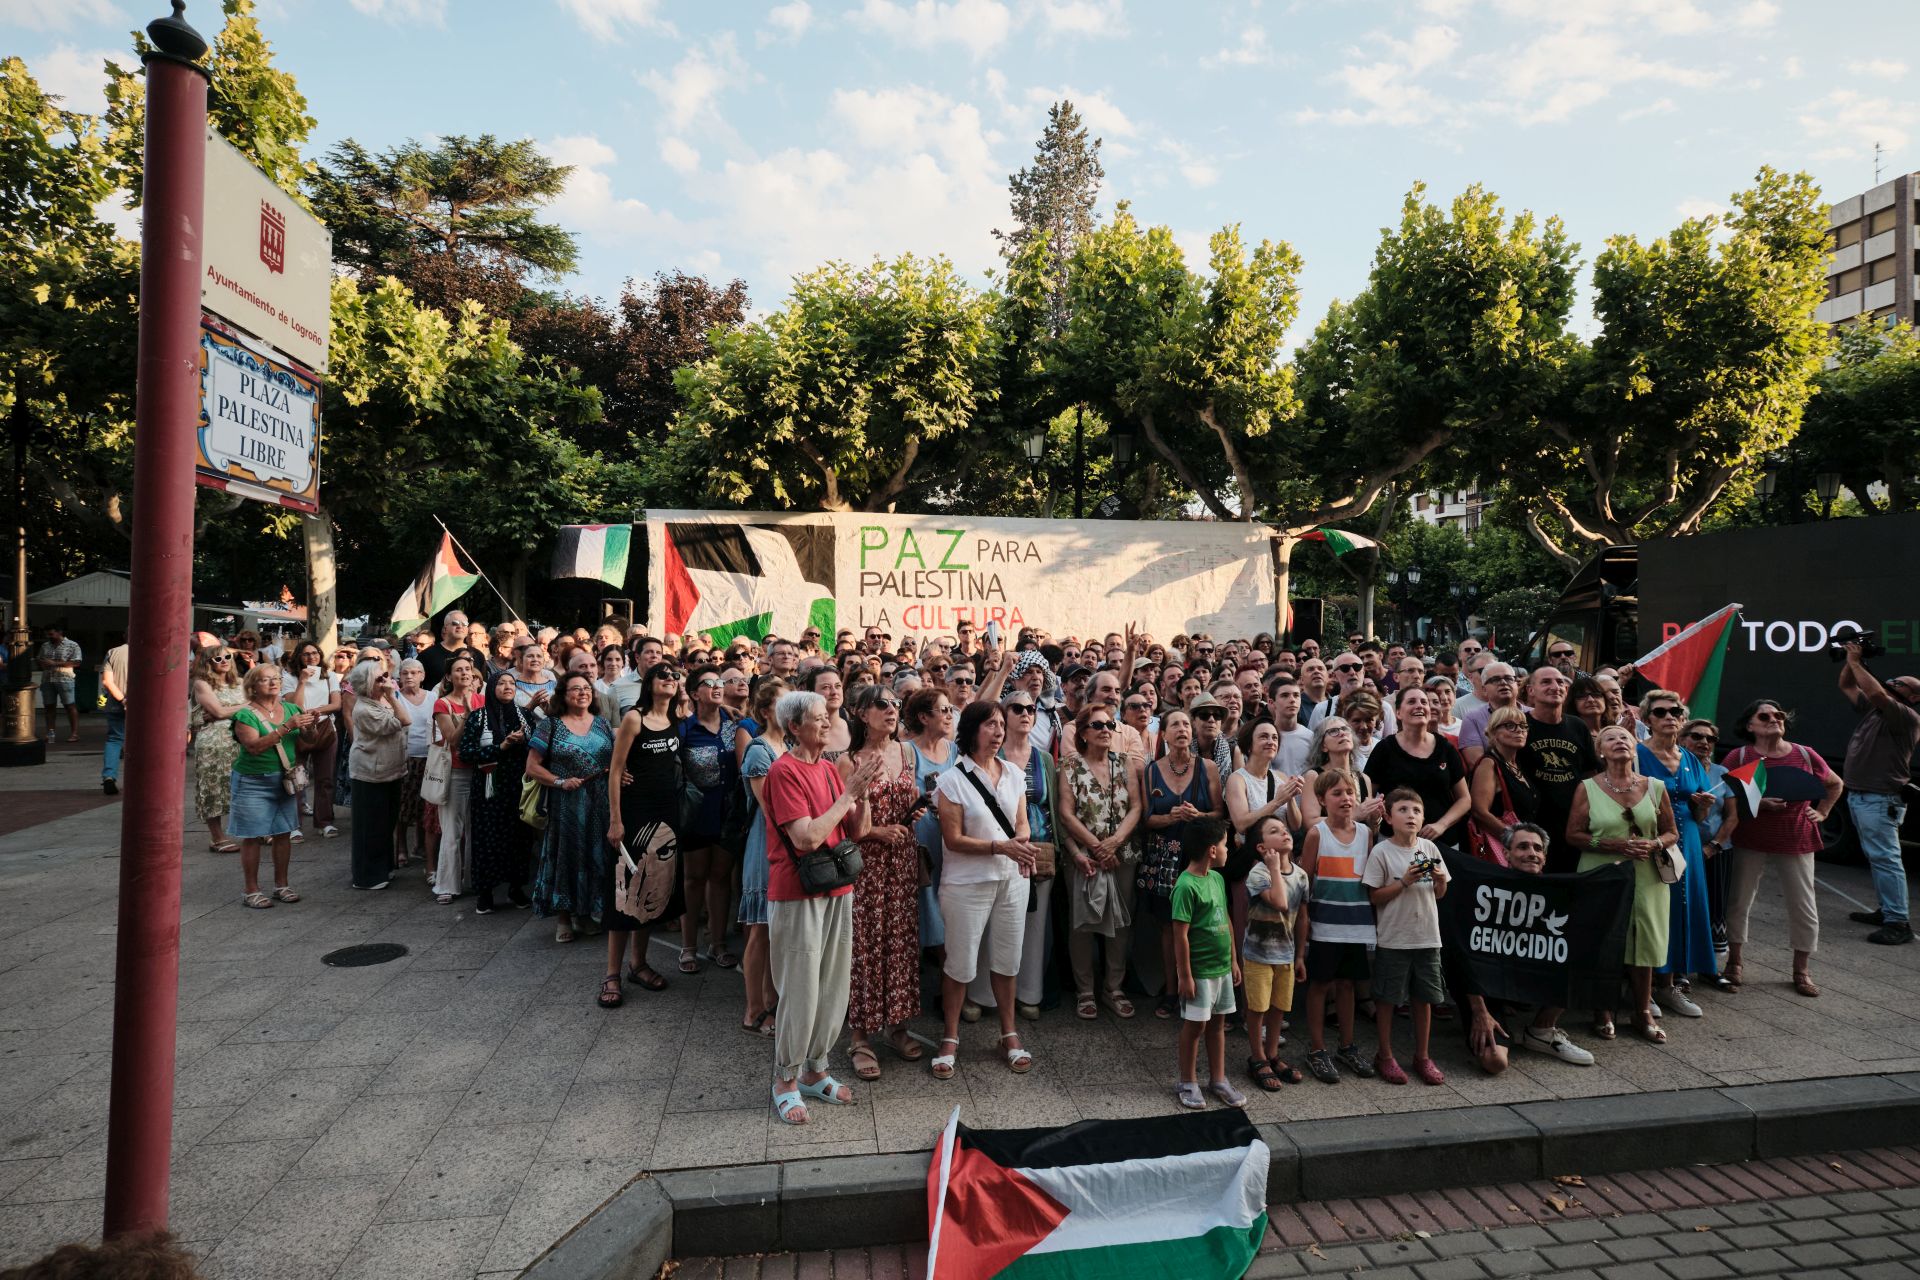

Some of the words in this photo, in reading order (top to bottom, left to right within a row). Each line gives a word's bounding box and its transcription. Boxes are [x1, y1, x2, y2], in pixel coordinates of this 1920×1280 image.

[207, 265, 276, 317] Ayuntamiento
[278, 310, 288, 325] de
[291, 318, 323, 346] Logroño
[239, 372, 291, 415] PLAZA
[218, 394, 305, 449] PALESTINA
[240, 435, 286, 470] LIBRE
[860, 525, 970, 570] PAZ
[977, 539, 1042, 563] PARA
[860, 570, 1007, 602] PALESTINA
[859, 605, 892, 628] LA
[902, 605, 1026, 631] CULTURA
[1530, 738, 1578, 754] REFUGEES
[1535, 769, 1575, 782] WELCOME
[1474, 884, 1546, 928] STOP
[1469, 925, 1569, 963] GENOCIDIO
